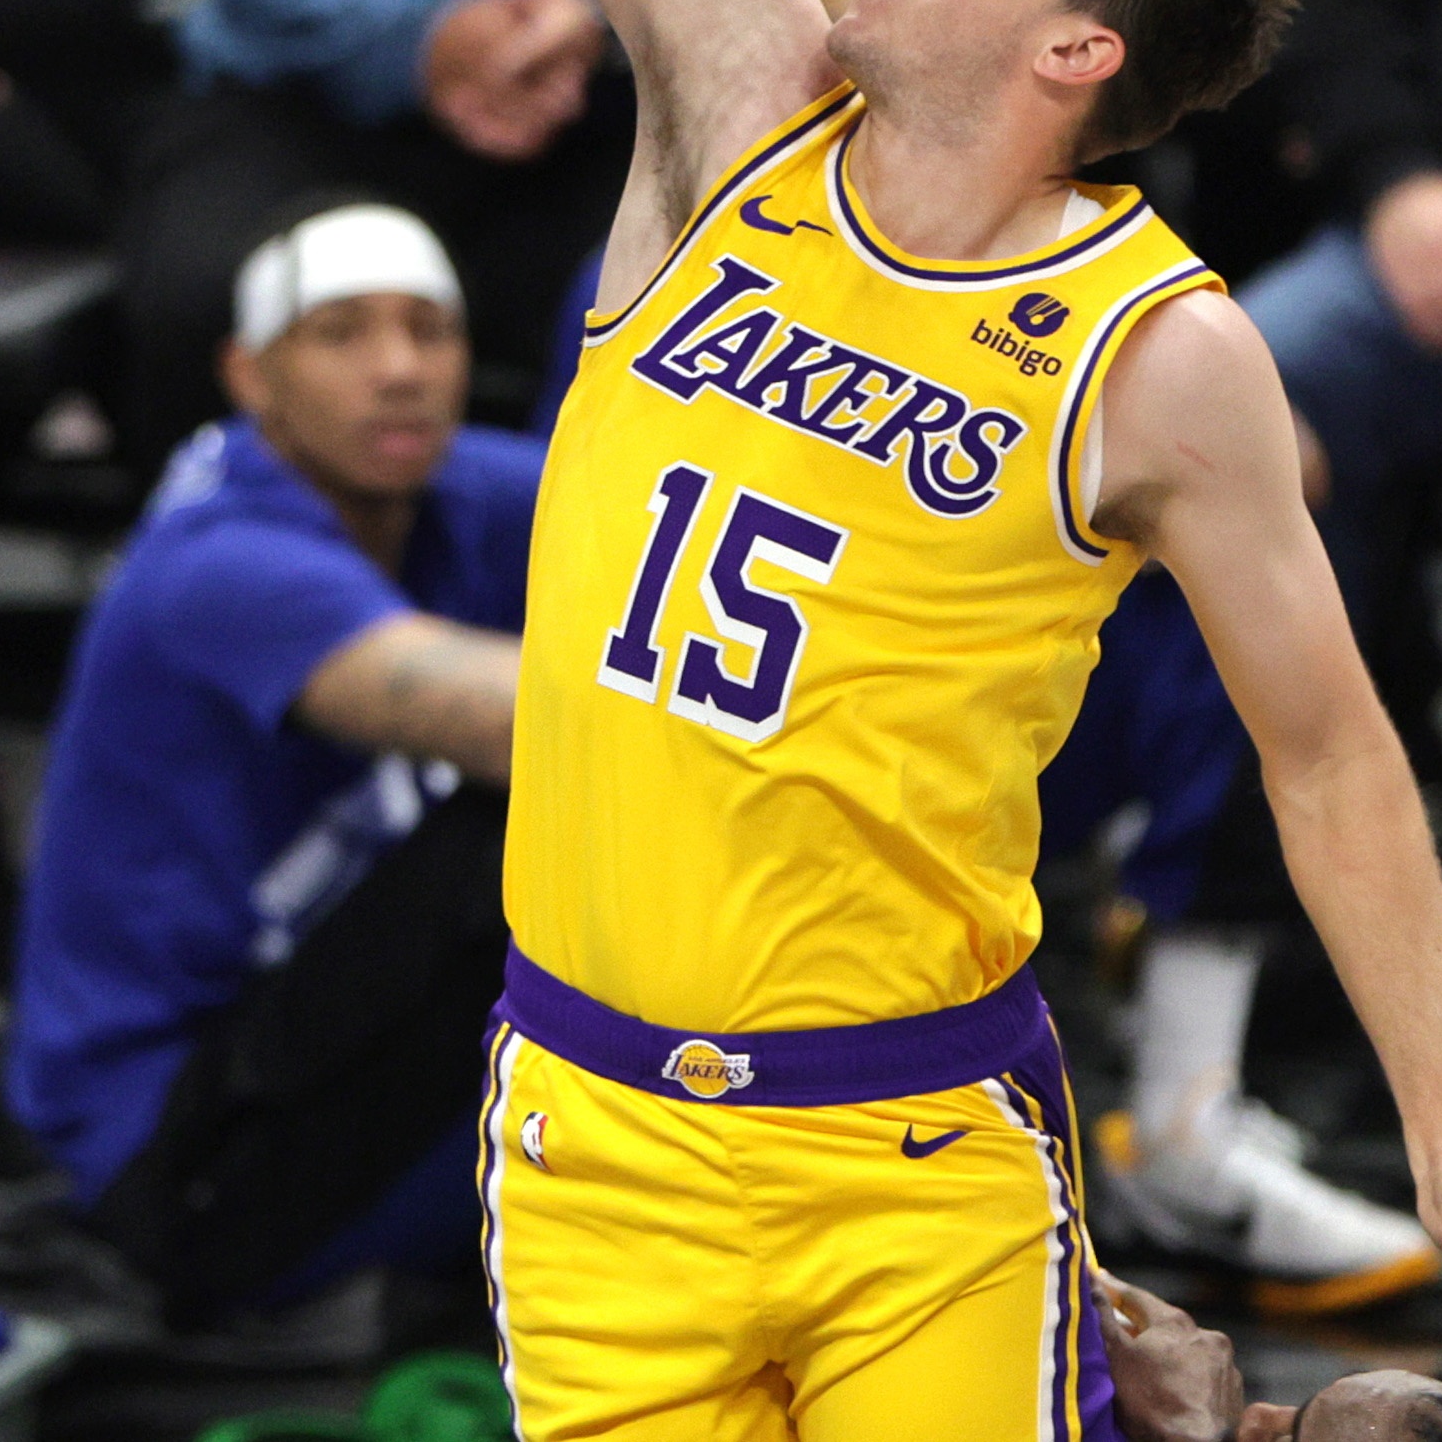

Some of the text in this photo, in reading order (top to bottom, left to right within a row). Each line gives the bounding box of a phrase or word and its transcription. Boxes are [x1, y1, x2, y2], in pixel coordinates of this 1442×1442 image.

[629, 252, 1029, 520] LAKERS
[970, 318, 1063, 378] bibigo
[597, 459, 850, 743] 15
[668, 1053, 748, 1086] LAKERS
